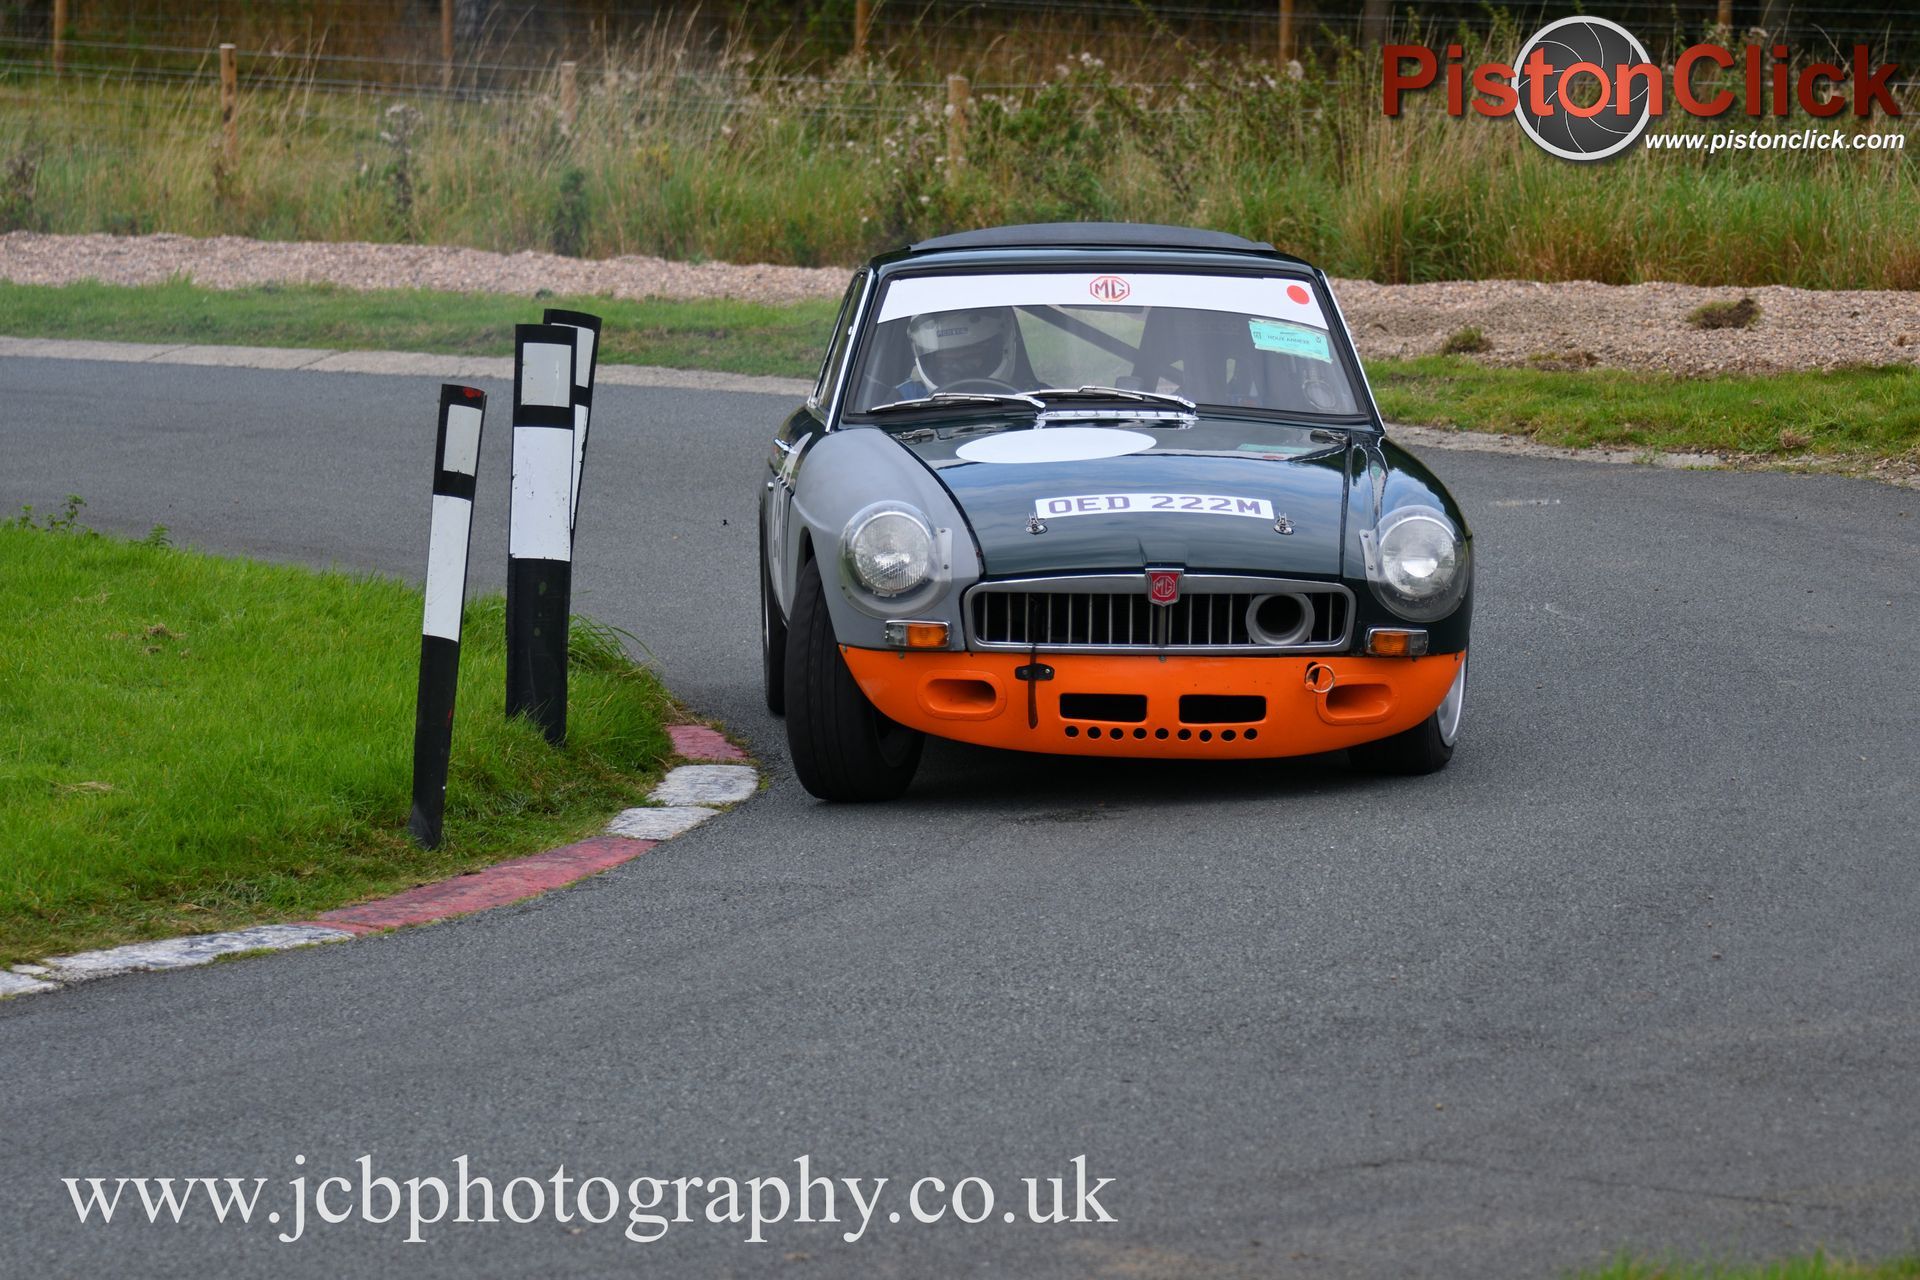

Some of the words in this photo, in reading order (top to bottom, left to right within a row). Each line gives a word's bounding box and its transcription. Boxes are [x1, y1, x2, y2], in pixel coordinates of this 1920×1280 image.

[1094, 279, 1125, 299] MG
[1048, 496, 1131, 515] OED
[1150, 495, 1262, 515] 222M
[1155, 578, 1173, 595] MG
